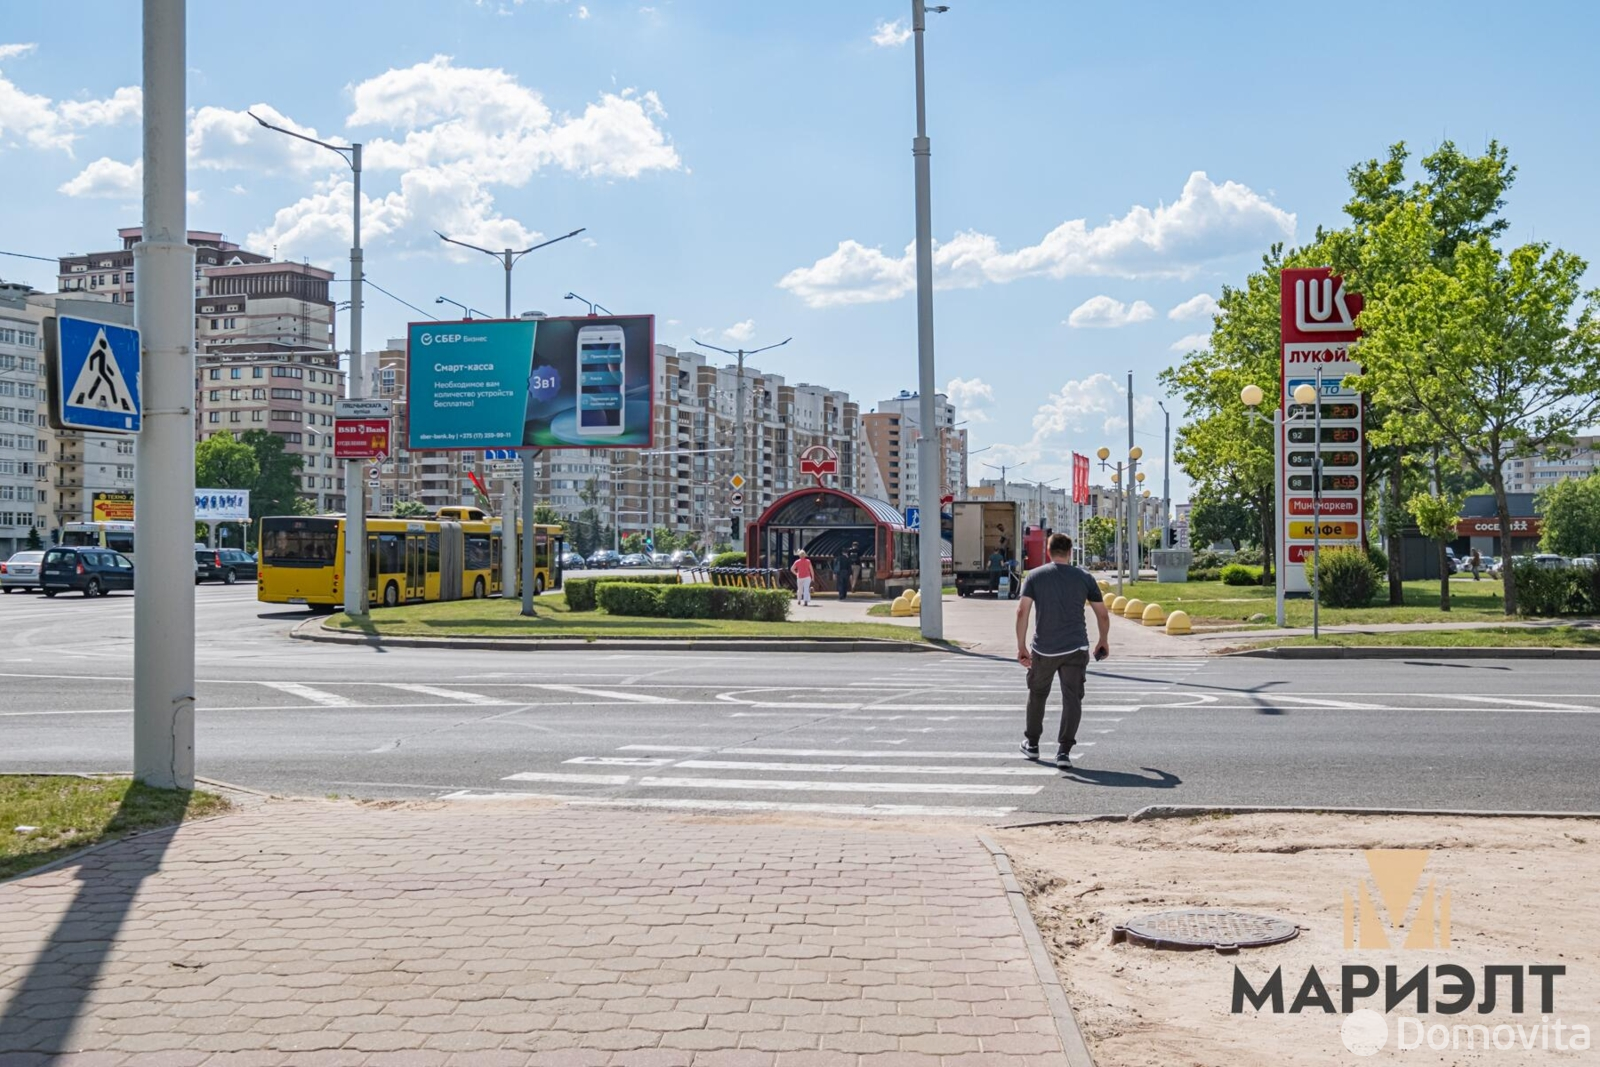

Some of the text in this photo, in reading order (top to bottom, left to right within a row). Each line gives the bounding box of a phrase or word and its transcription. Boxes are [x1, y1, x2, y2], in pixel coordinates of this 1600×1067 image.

[434, 334, 461, 343] СБЕР
[1289, 347, 1352, 363] ЛУКОЙ
[434, 363, 494, 373] Смарт-касса
[434, 381, 484, 389] Необходимое
[533, 376, 555, 389] 3в1
[477, 389, 514, 398] устройств
[1292, 455, 1302, 463] 95
[1292, 479, 1302, 487] 98
